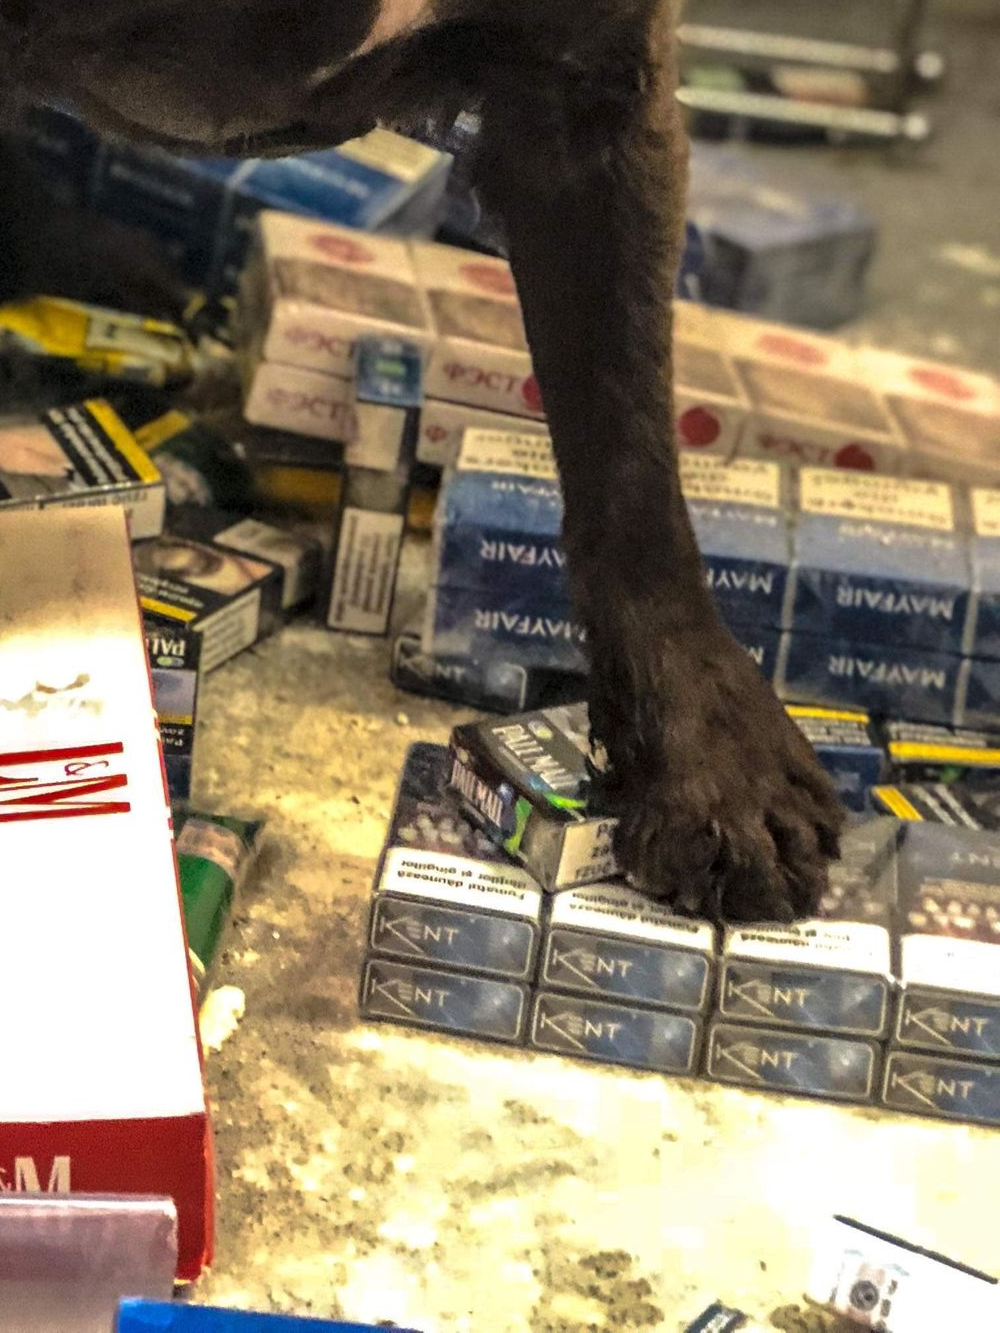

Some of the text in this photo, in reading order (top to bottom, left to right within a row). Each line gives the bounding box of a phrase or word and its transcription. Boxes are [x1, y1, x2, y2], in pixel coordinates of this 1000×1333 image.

[837, 585, 954, 621] MAYFAIR
[828, 654, 946, 690] MAYFAIR
[379, 915, 460, 955] KENT
[552, 947, 633, 990] KENT
[371, 977, 450, 1016] KENT
[540, 1011, 621, 1052] KENT
